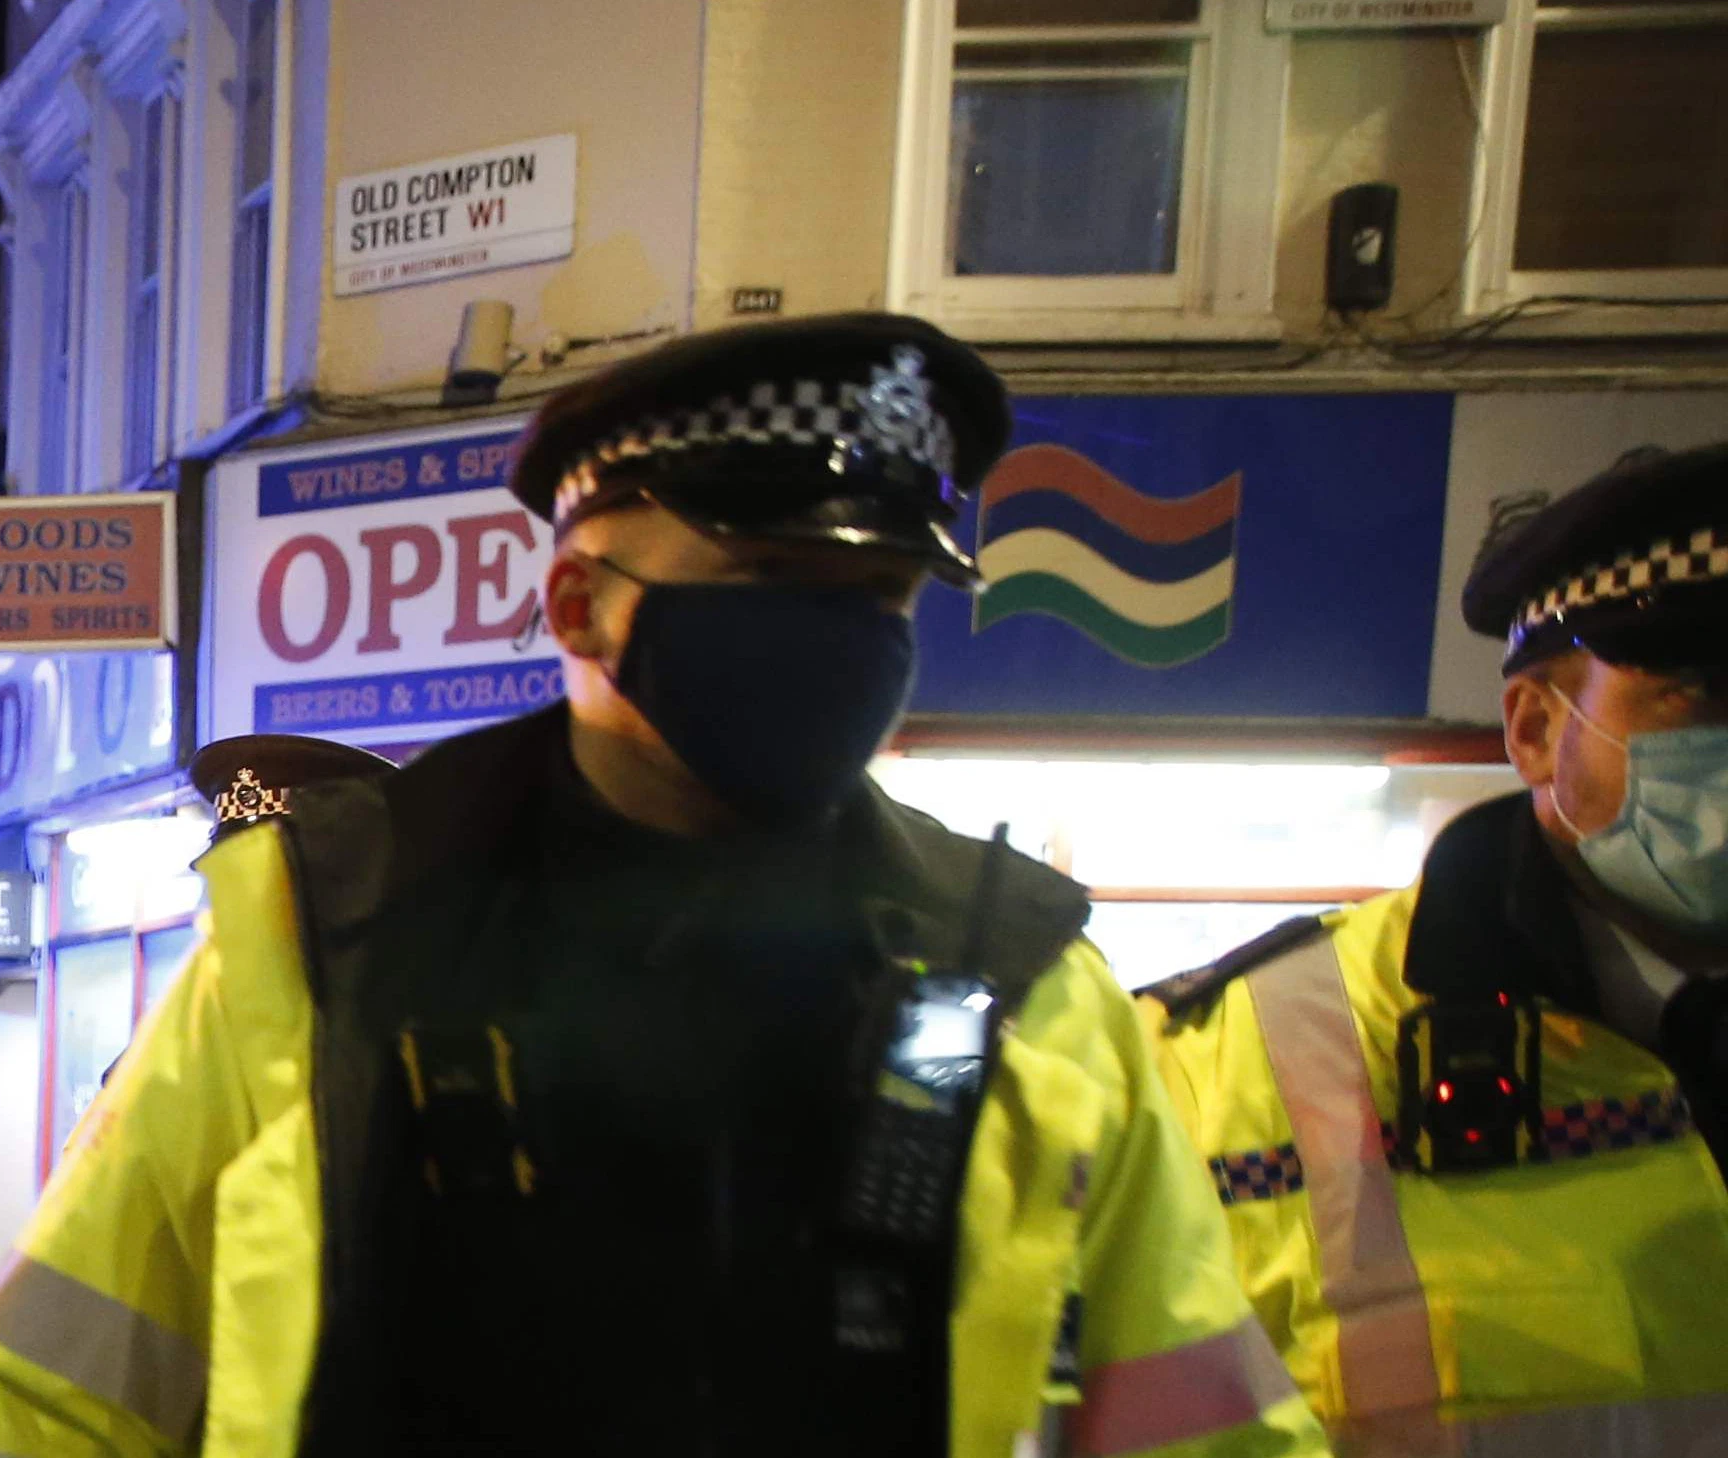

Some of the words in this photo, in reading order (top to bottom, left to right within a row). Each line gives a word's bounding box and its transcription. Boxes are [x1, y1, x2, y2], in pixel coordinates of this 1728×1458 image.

[351, 180, 399, 216] OLD
[406, 153, 538, 205] COMPTON
[350, 206, 449, 252] STREET
[466, 197, 506, 231] W1
[288, 457, 407, 503] WINES
[417, 453, 446, 486] &
[457, 445, 510, 481] SP
[257, 508, 548, 664] OPE
[52, 605, 151, 631] SPIRITS
[270, 684, 380, 725] BEERS
[391, 682, 415, 714] &
[422, 667, 565, 713] TOBACC
